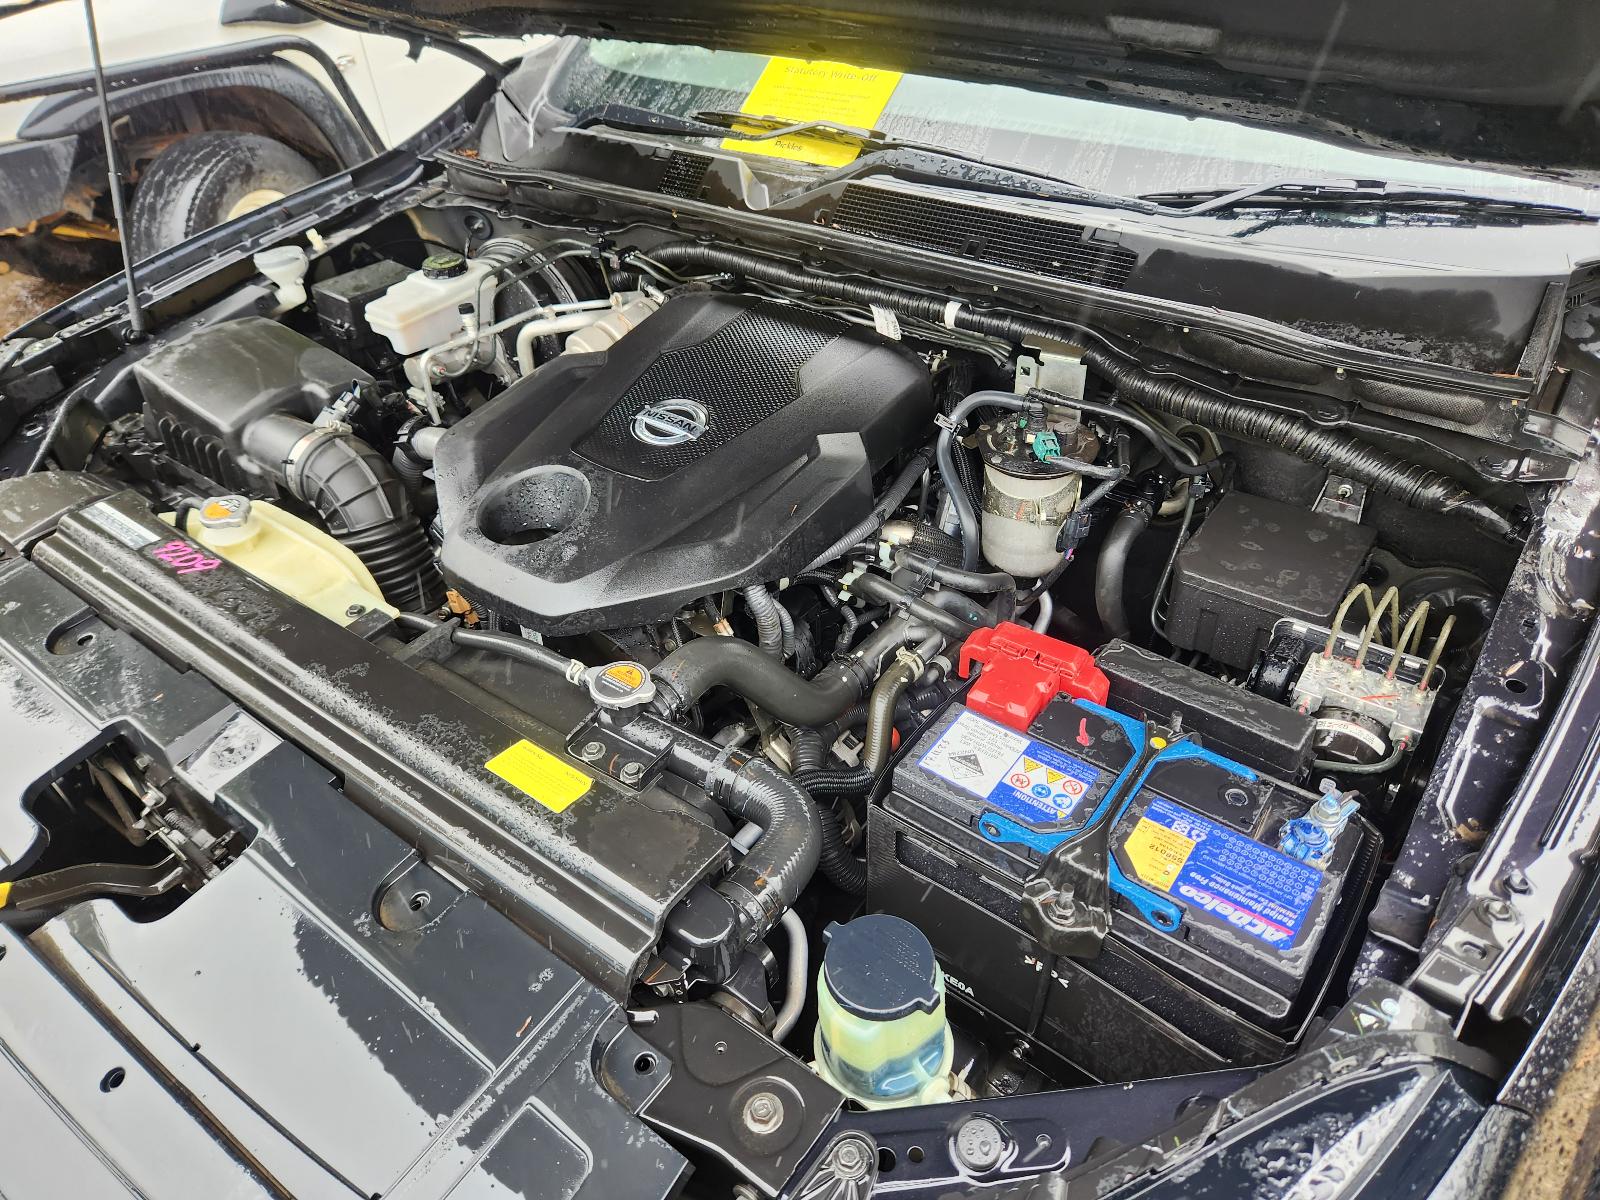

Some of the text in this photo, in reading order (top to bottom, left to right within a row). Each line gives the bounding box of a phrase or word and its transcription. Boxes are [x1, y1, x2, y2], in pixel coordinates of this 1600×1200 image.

[774, 140, 803, 151] Pickles
[642, 409, 697, 432] NISSAN
[1011, 789, 1057, 815] ATTENTION!
[1188, 870, 1209, 885] Free
[1207, 880, 1264, 912] Maintenance
[1178, 884, 1288, 943] ACDelco
